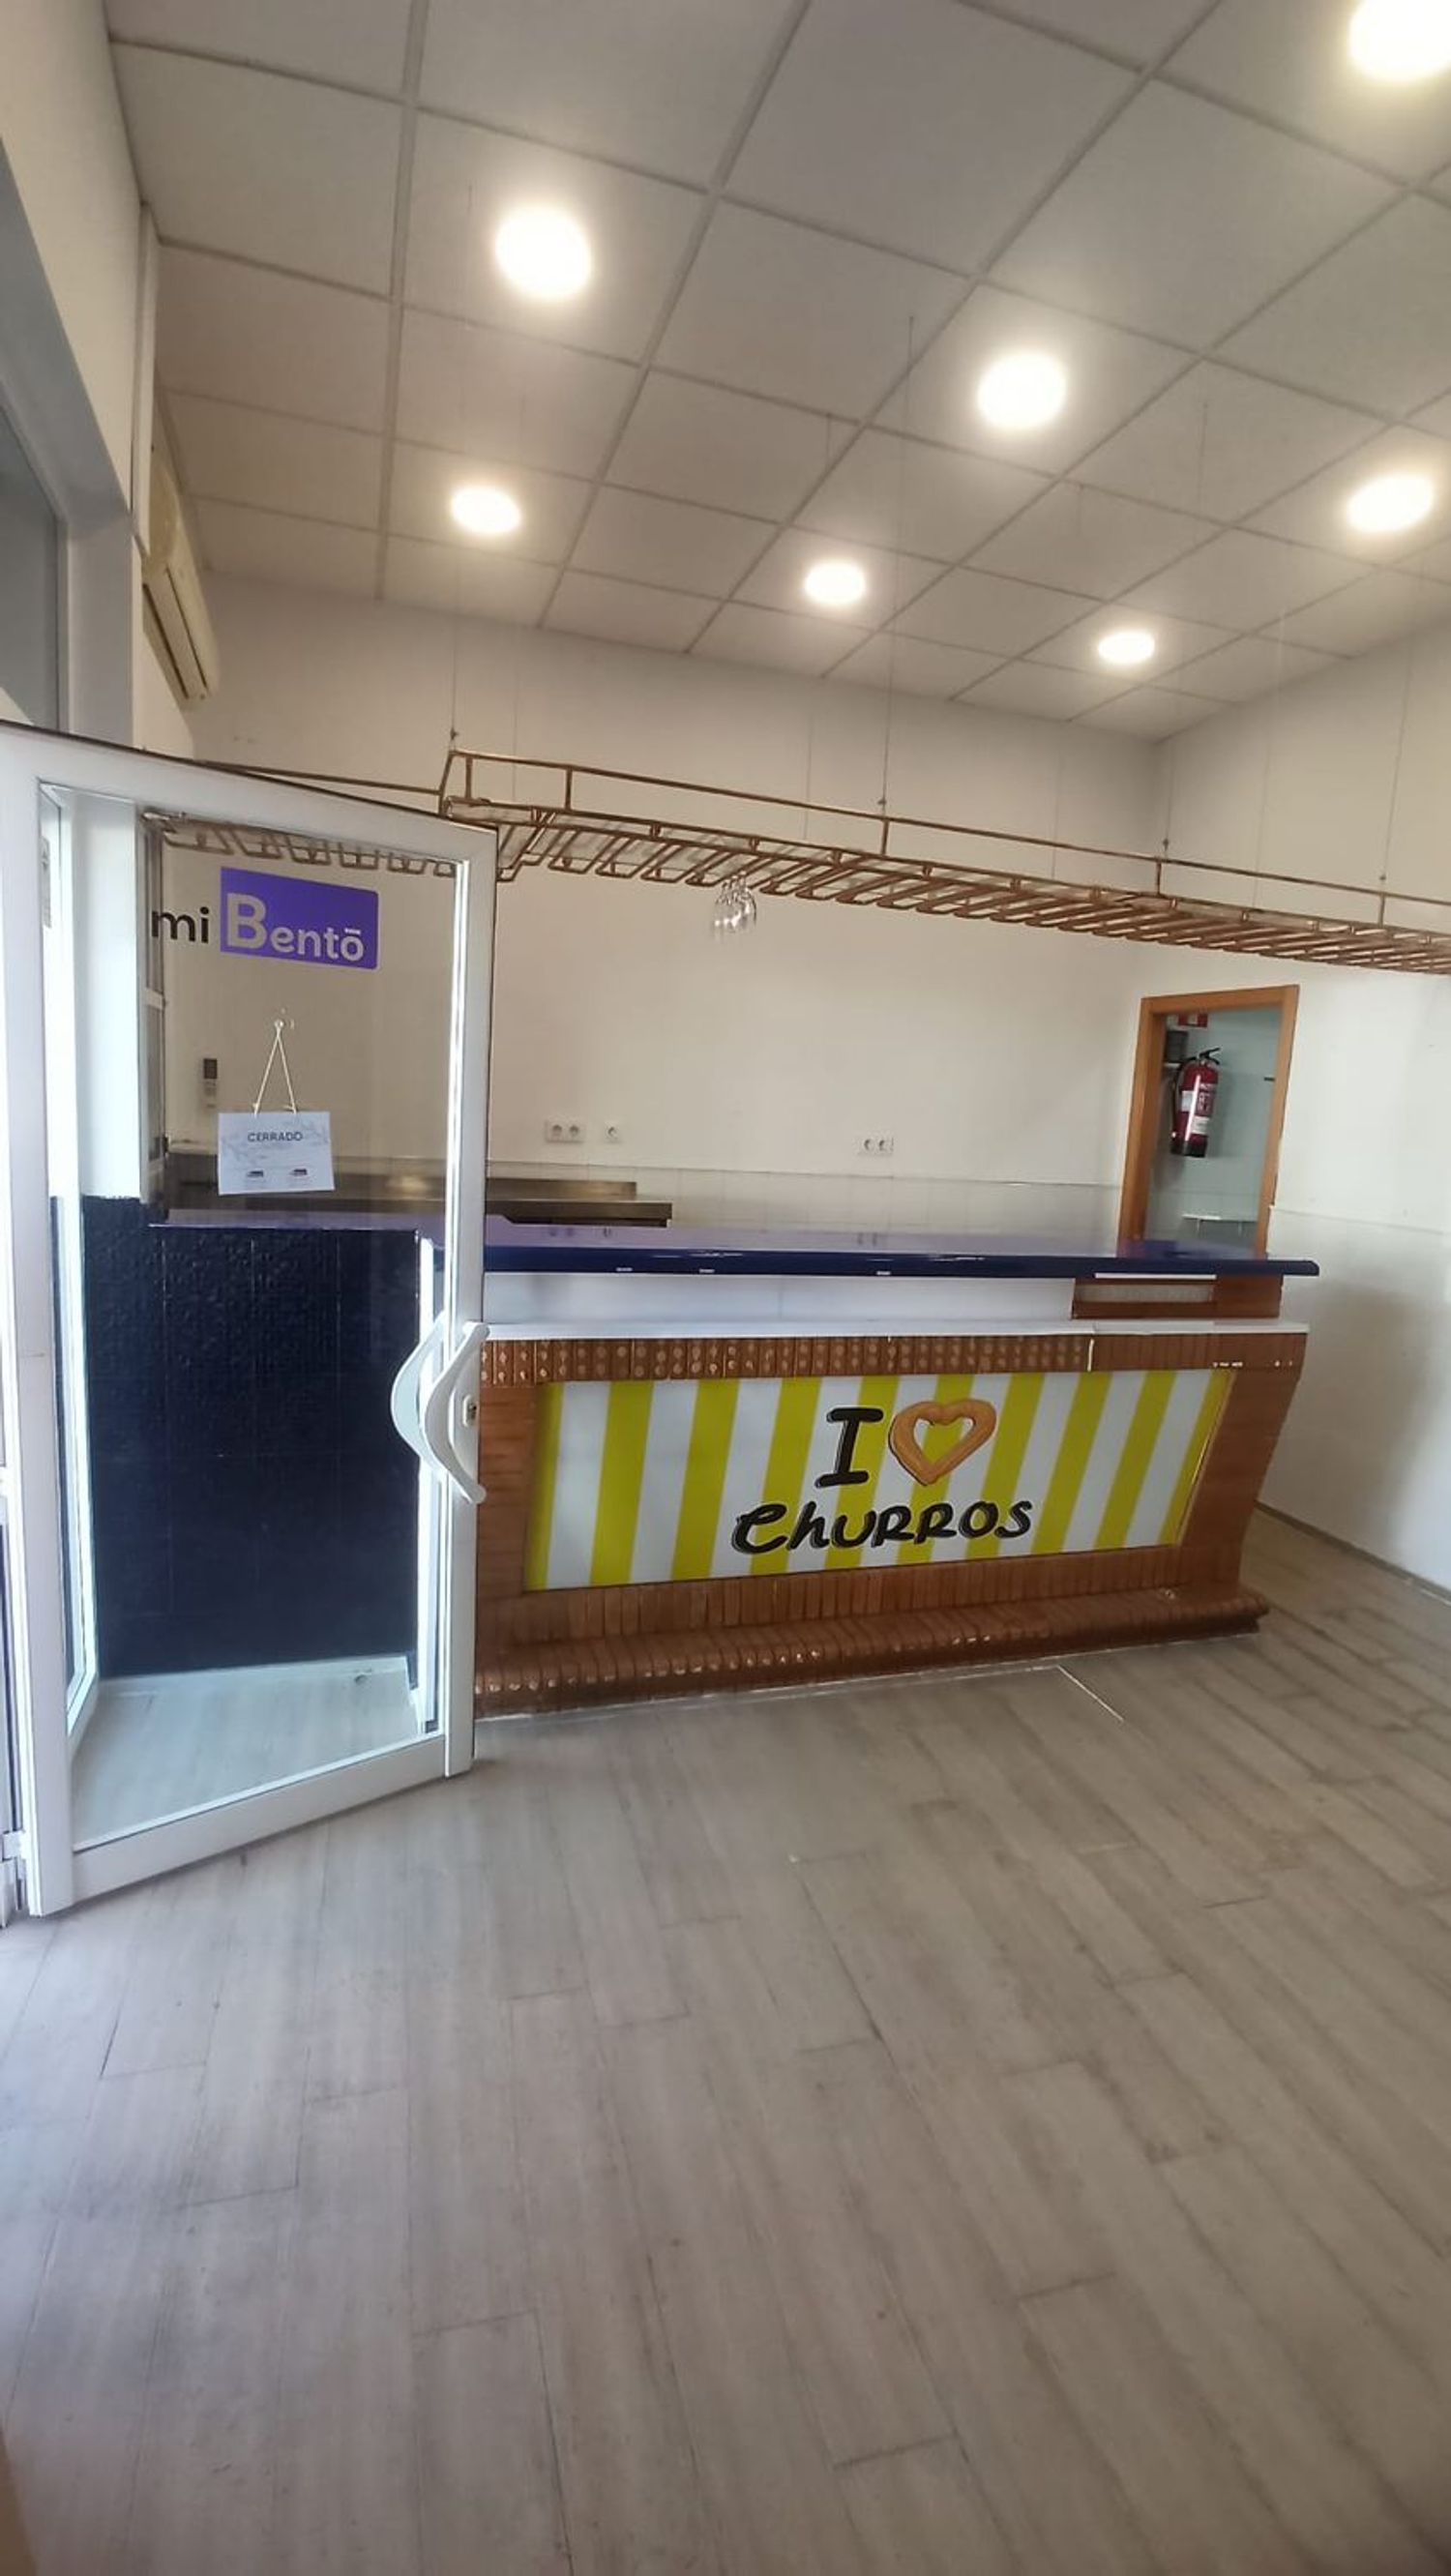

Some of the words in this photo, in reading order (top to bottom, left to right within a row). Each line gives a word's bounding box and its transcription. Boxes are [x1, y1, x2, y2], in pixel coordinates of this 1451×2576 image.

[151, 906, 210, 944] mi
[225, 892, 365, 962] Bentō
[247, 1131, 304, 1142] CERRADO
[814, 1406, 884, 1489] I
